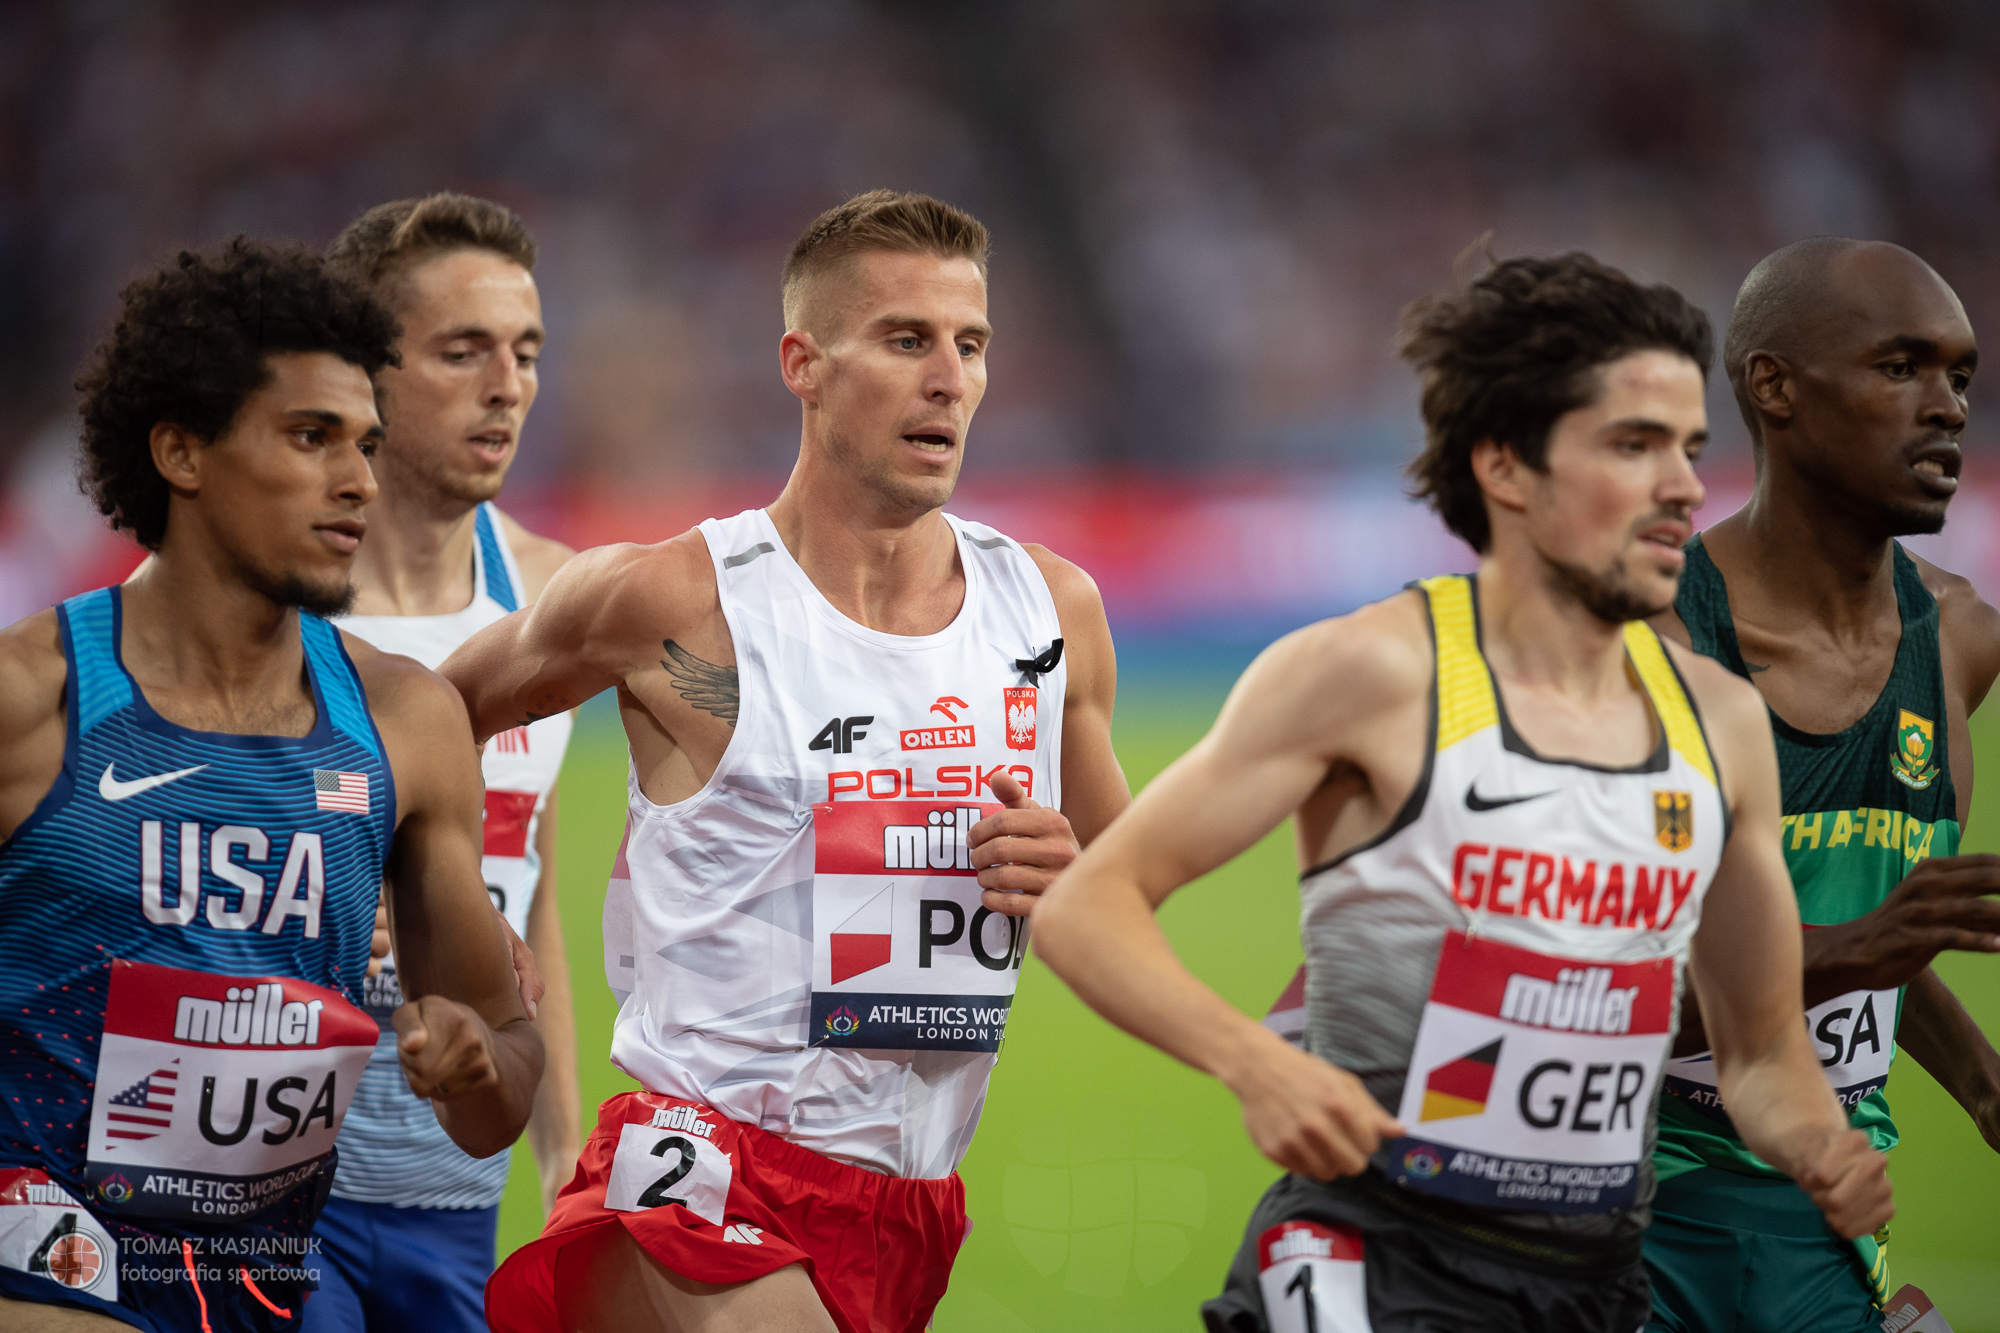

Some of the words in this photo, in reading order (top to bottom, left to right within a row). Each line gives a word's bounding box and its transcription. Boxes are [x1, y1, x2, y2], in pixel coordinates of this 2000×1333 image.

[1006, 690, 1036, 698] POLSKA
[808, 715, 875, 754] 4F
[904, 728, 973, 748] ORLEN
[828, 764, 1034, 802] POLSKA
[883, 806, 982, 870] müll
[141, 820, 325, 939] USA
[1453, 841, 1698, 932] GERMANY
[173, 982, 325, 1046] müller
[867, 1005, 967, 1025] ATHLETICS
[1500, 966, 1640, 1035] müller
[916, 1027, 989, 1040] LONDON
[1803, 992, 1881, 1068] SA
[197, 1070, 337, 1147] USA
[1517, 1057, 1645, 1132] GER
[651, 1105, 717, 1139] müller
[141, 1174, 246, 1201] ATHLETICS
[249, 1171, 295, 1198] WORLD
[295, 1161, 319, 1182] CUP
[636, 1136, 697, 1209] 2
[1448, 1151, 1548, 1185] ATHLETICS
[1550, 1164, 1608, 1188] WORLD
[1606, 1165, 1634, 1188] CUP
[192, 1200, 257, 1216] LONDON
[1496, 1182, 1564, 1200] LONDON
[28, 1212, 82, 1286] 4
[1268, 1228, 1334, 1263] müller
[1285, 1263, 1318, 1333] 1
